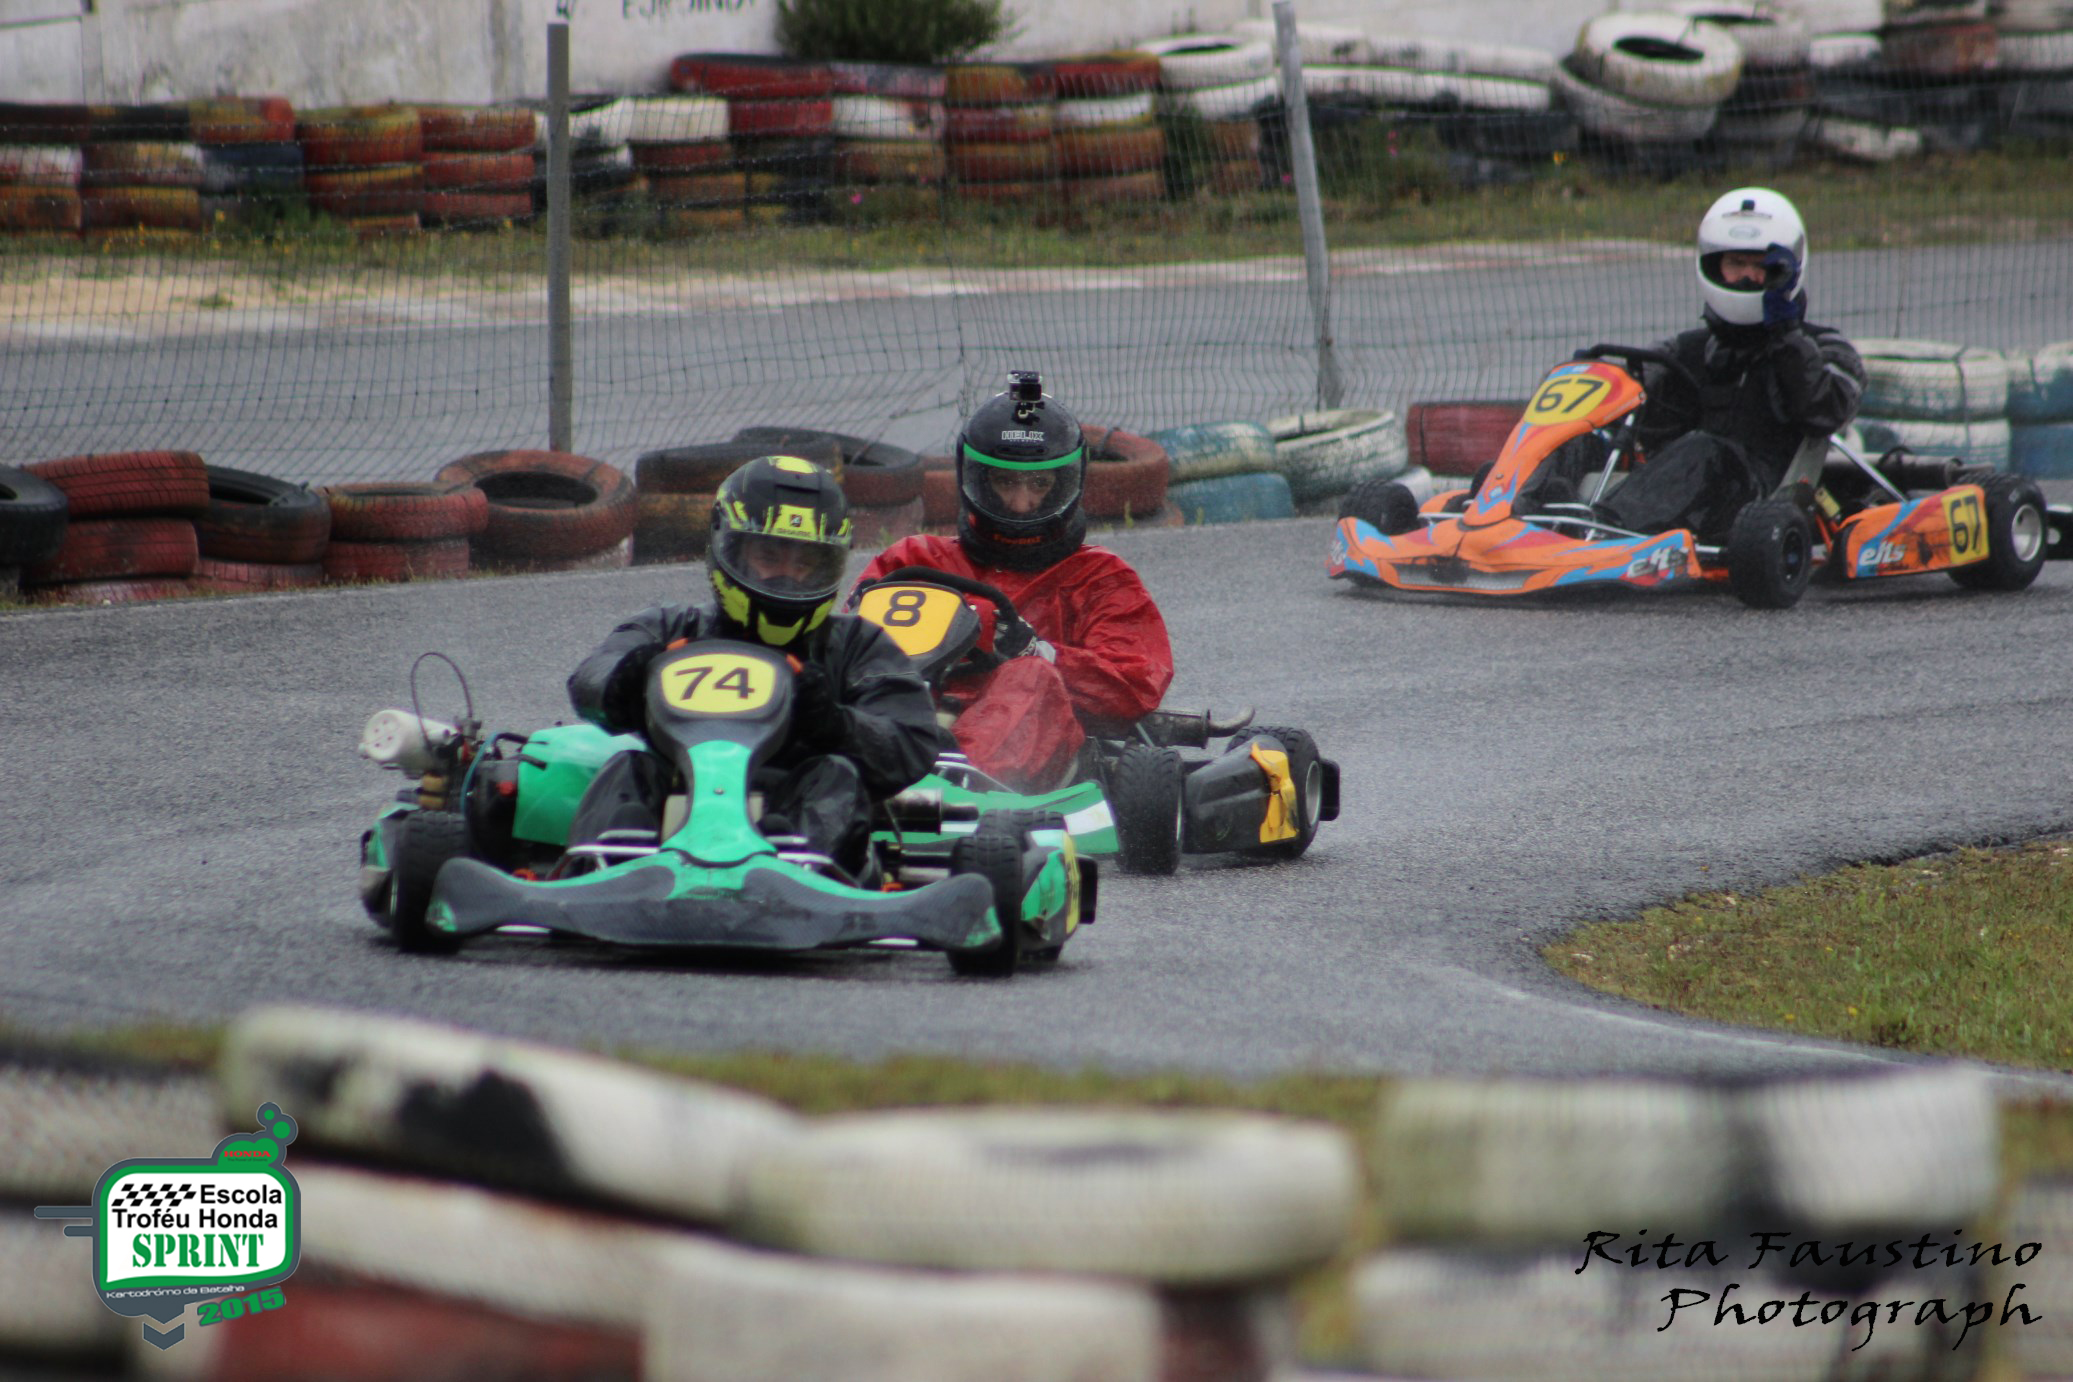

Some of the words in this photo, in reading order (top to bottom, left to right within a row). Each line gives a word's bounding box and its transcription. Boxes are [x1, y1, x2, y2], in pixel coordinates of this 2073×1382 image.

[1534, 377, 1605, 415] 67
[1001, 430, 1045, 441] HELIX
[1950, 494, 1982, 554] 67
[882, 589, 927, 627] 8
[673, 665, 756, 701] 74
